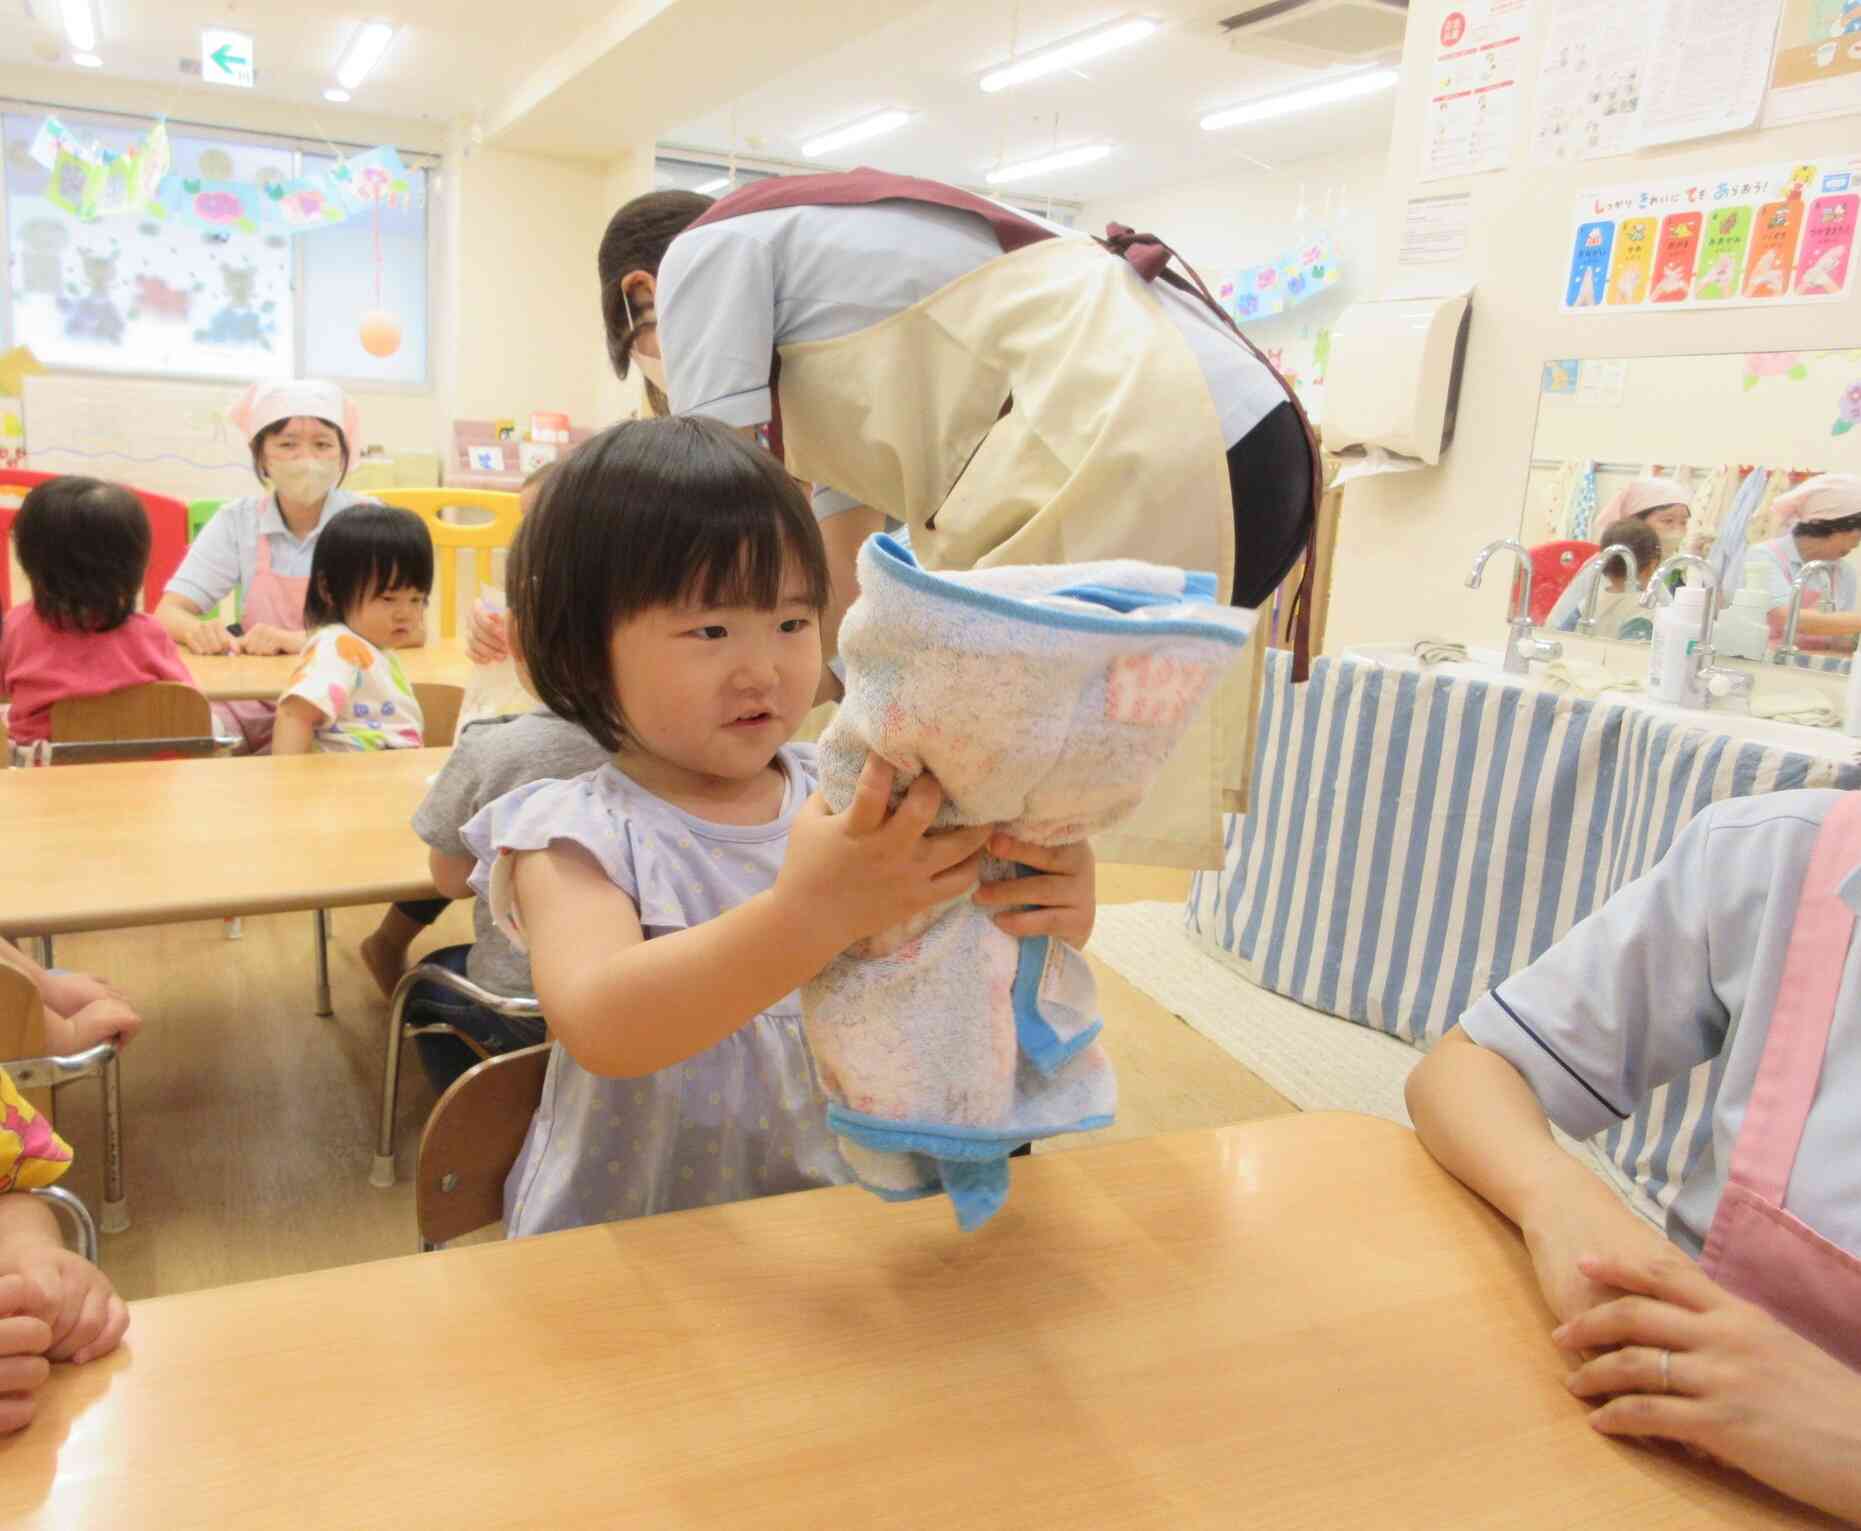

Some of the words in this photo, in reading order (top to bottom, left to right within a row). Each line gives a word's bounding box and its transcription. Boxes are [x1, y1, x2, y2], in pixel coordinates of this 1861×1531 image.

[1594, 199, 1632, 214] しっかり
[1639, 191, 1680, 209] きれいに
